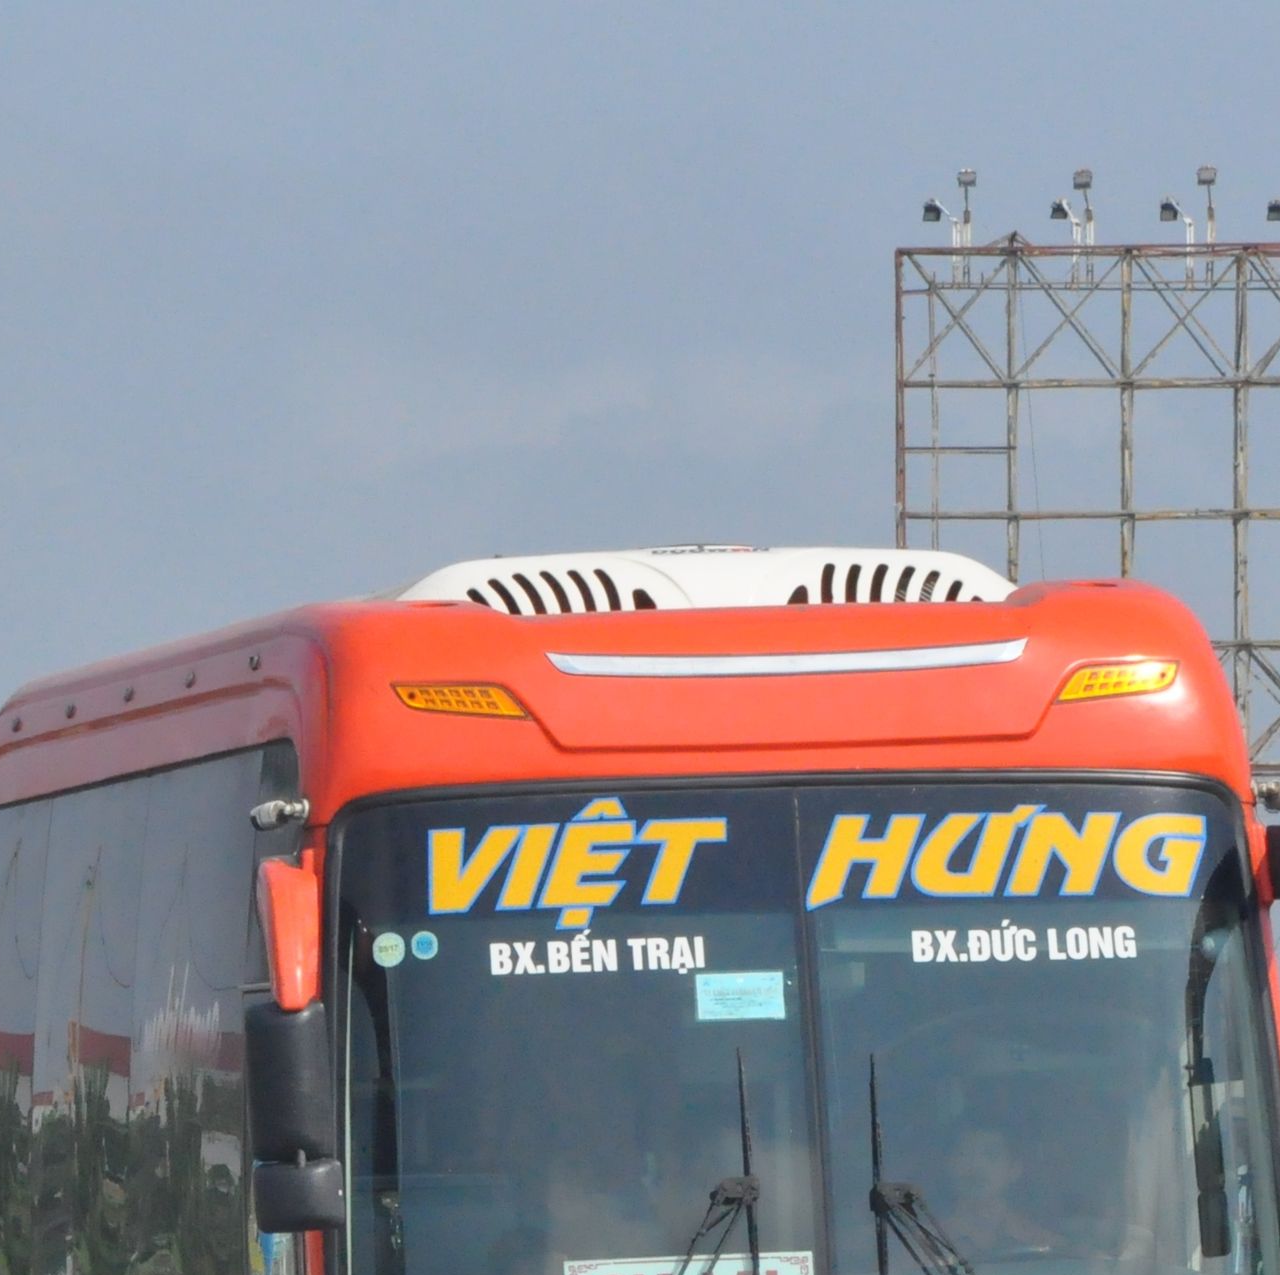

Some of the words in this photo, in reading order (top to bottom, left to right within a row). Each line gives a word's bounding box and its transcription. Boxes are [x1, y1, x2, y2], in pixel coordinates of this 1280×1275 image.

[427, 797, 728, 930] VIỆT
[806, 804, 1207, 911] HƯNG
[489, 929, 618, 975] BX.BẾN
[627, 936, 706, 974] TRẠI
[911, 919, 1036, 963] BX.ĐỨC
[1047, 925, 1137, 960] LONG
